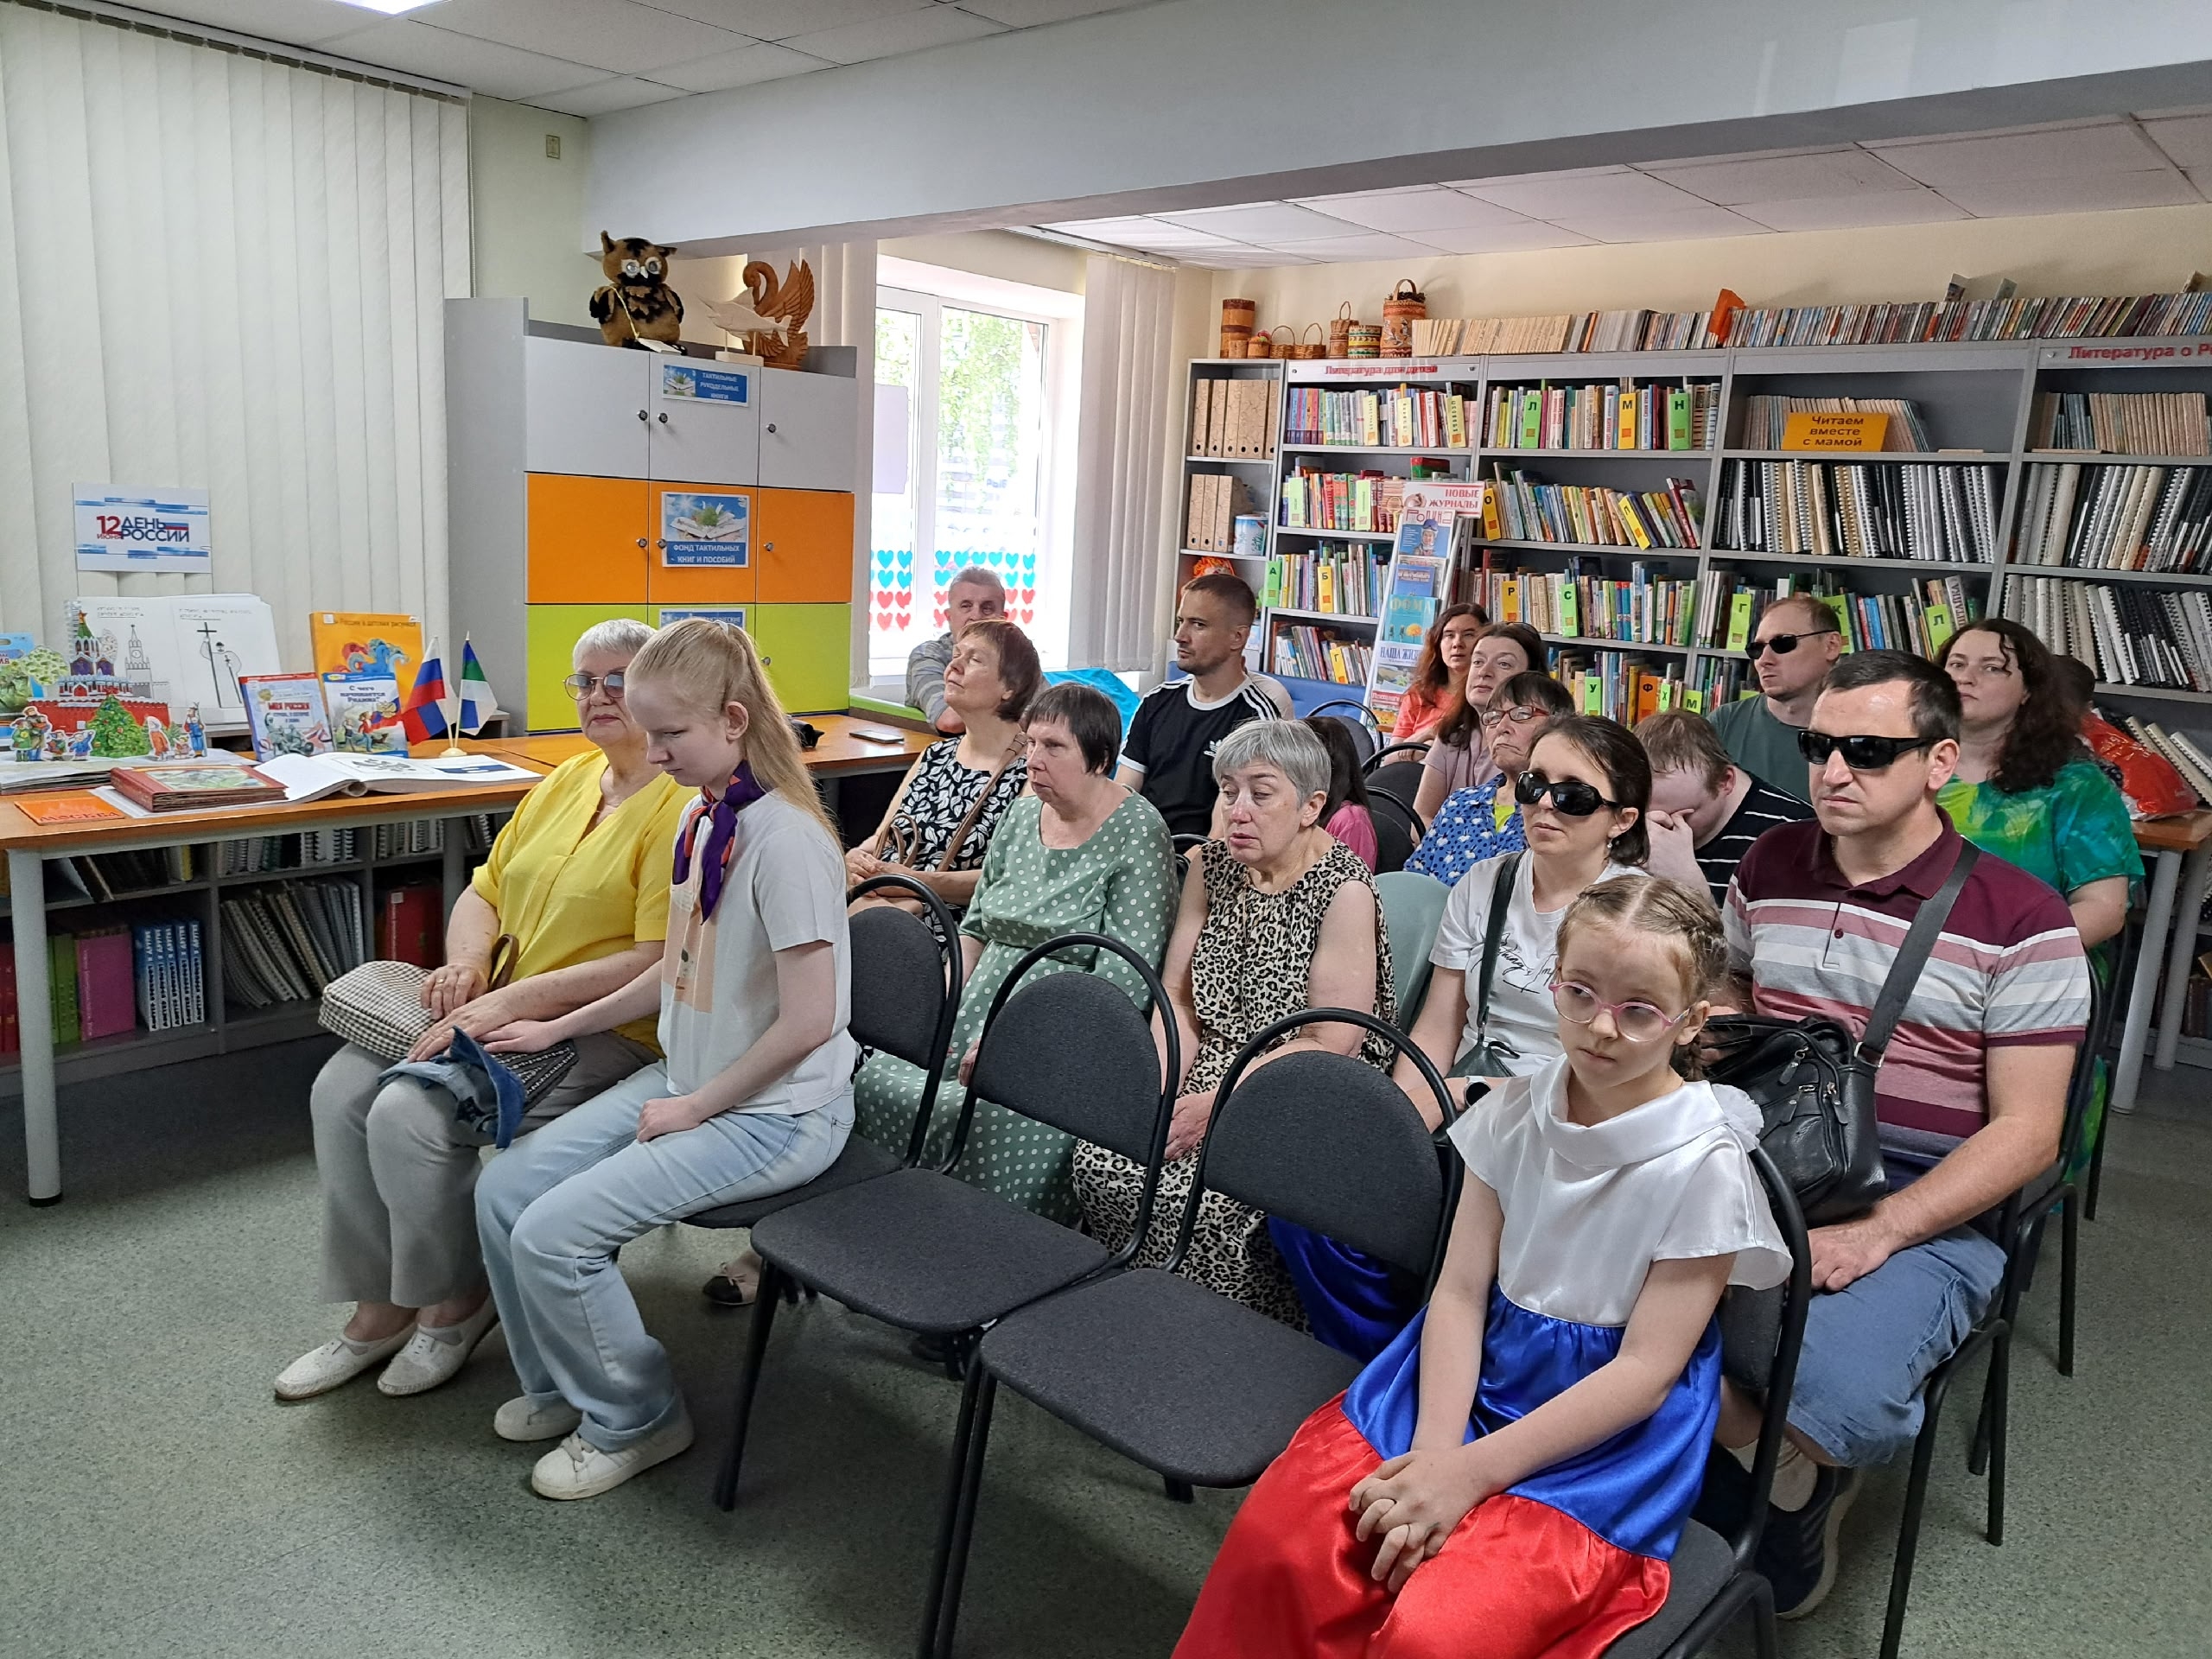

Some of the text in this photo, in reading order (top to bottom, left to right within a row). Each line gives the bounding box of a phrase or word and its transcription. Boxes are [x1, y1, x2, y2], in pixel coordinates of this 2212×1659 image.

[2069, 344, 2212, 360] Литература о Р
[1325, 365, 1382, 377] Литература
[1528, 401, 1537, 411] Л
[1622, 400, 1632, 410] М
[1675, 400, 1684, 410] Н
[1812, 416, 1864, 425] Читаем
[1815, 437, 1862, 446] мамой
[1445, 489, 1479, 499] НОВЫЕ
[1428, 499, 1478, 509] ЖУРНАЛЫ
[97, 516, 166, 537] 12 ДЕНЬ
[121, 528, 189, 543] РОССИИ
[674, 544, 694, 553] ФОНД
[703, 555, 735, 563] ПОСОБИЙ
[1508, 588, 1515, 596] Р
[1564, 591, 1572, 600] С
[1738, 603, 1747, 613] Г
[1933, 613, 1945, 626] Л
[1334, 653, 1340, 662] Г
[1380, 646, 1401, 659] НАША
[1643, 683, 1653, 692] Ф
[1686, 698, 1697, 709] М
[40, 811, 120, 822] МОСКВА
